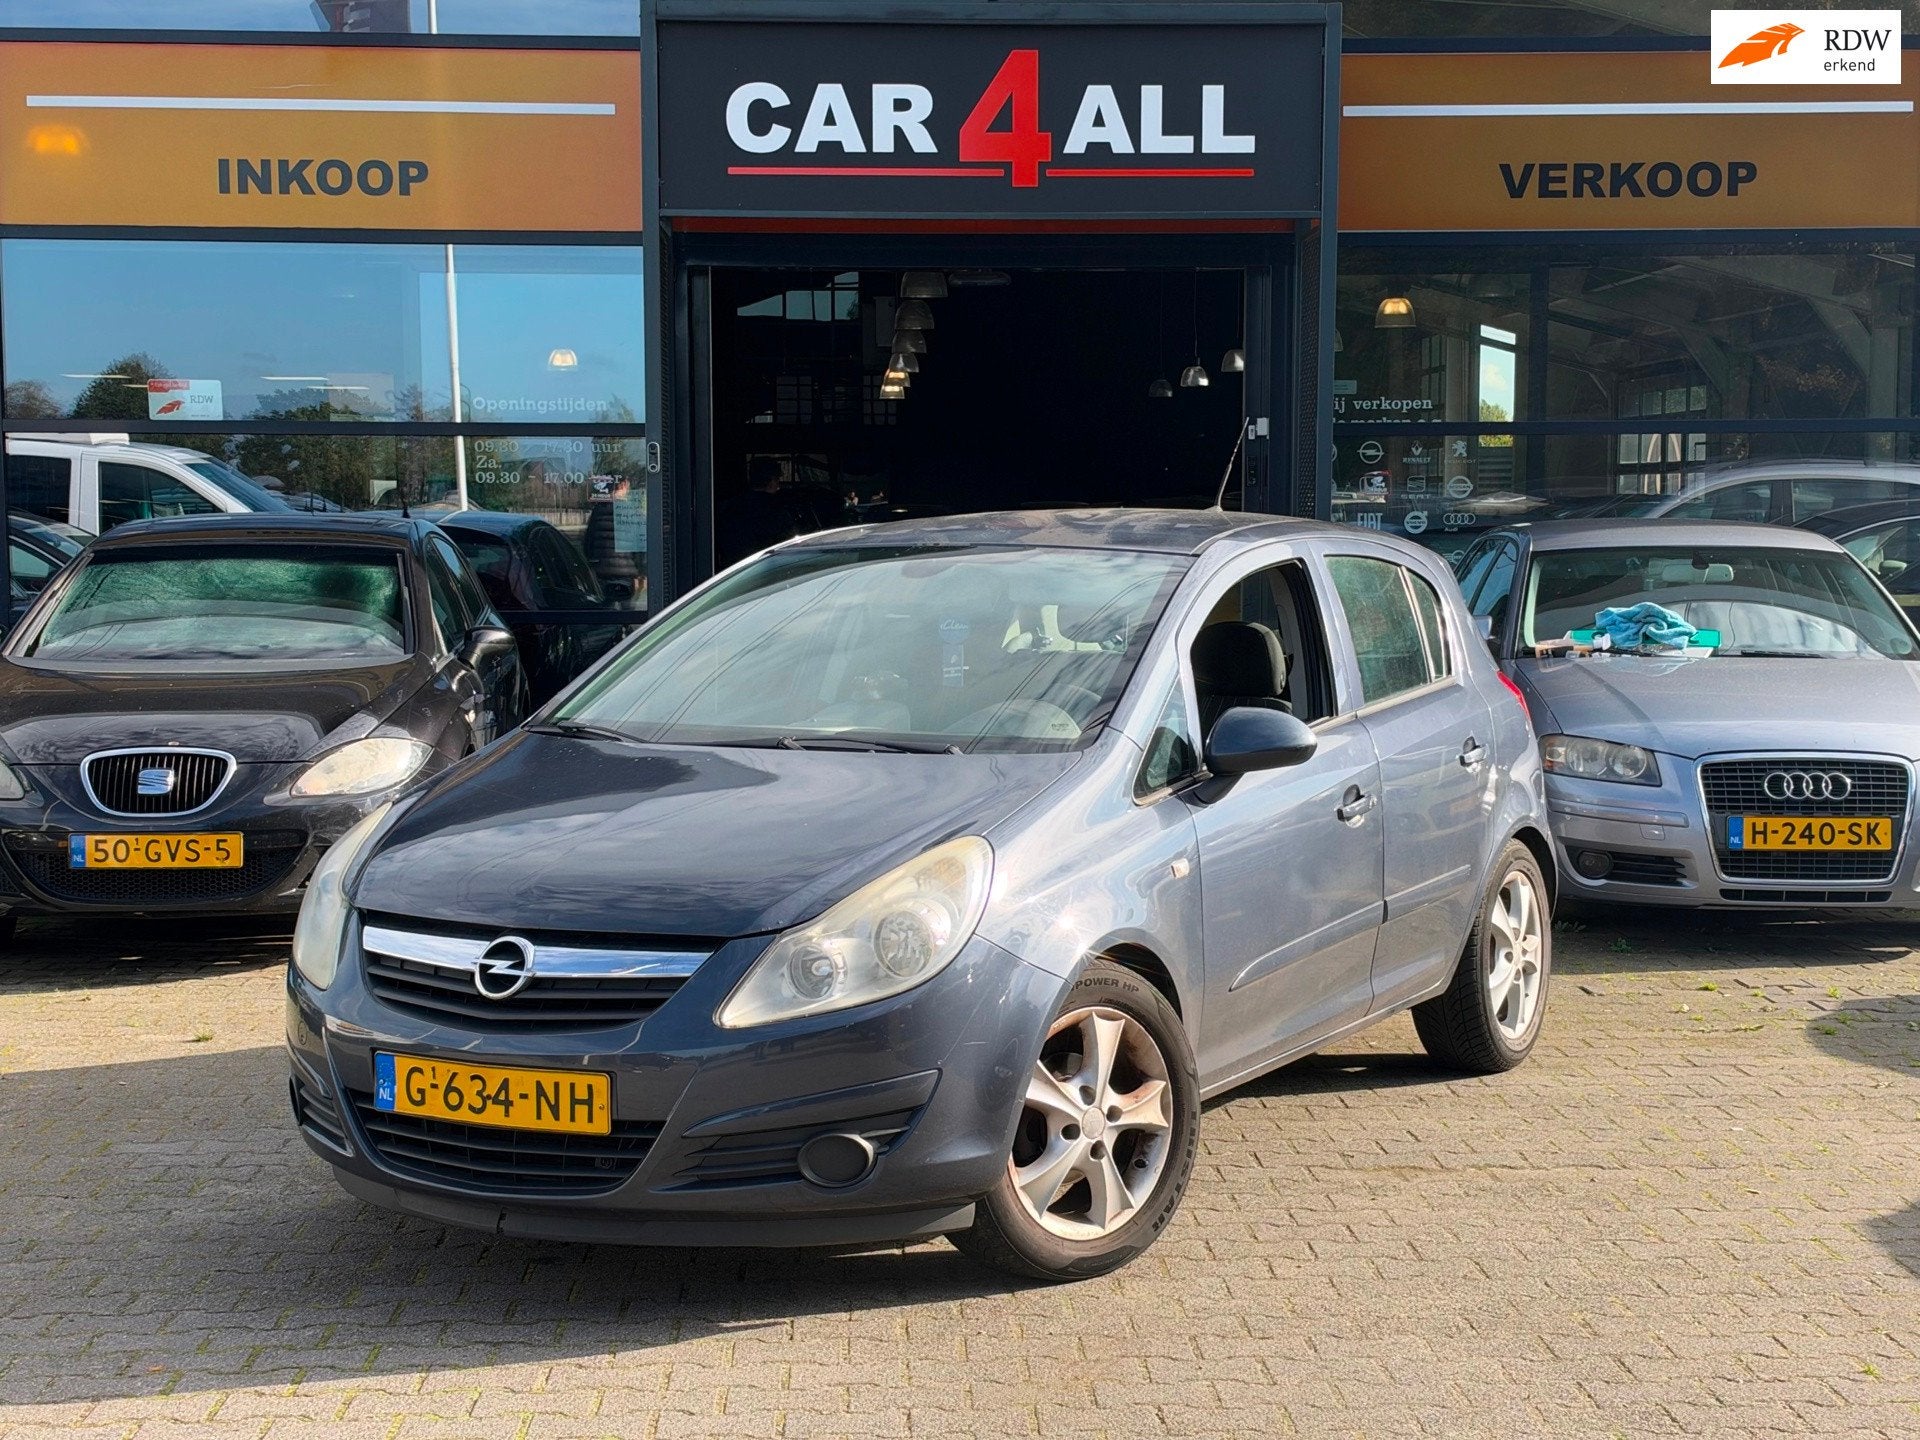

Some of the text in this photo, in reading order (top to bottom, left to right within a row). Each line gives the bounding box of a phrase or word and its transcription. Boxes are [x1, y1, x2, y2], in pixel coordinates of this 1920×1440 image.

[725, 49, 1256, 188] CAR 4 ALL
[217, 157, 429, 197] INKOOP
[1499, 161, 1758, 199] VERKOOP
[189, 394, 214, 404] RDW
[472, 396, 608, 414] Openingstijden
[1333, 396, 1434, 414] ij verkopen
[474, 440, 519, 453] 09.30
[590, 442, 622, 453] uur
[475, 455, 503, 469] Za.
[474, 471, 521, 484] 09.30
[543, 472, 585, 484] 17.00
[1357, 512, 1383, 531] FIAT
[1730, 836, 1742, 845] NL
[1750, 821, 1883, 846] H-240-SK
[73, 853, 85, 863] NL
[1071, 977, 1119, 991] POWER
[378, 1087, 393, 1101] NL
